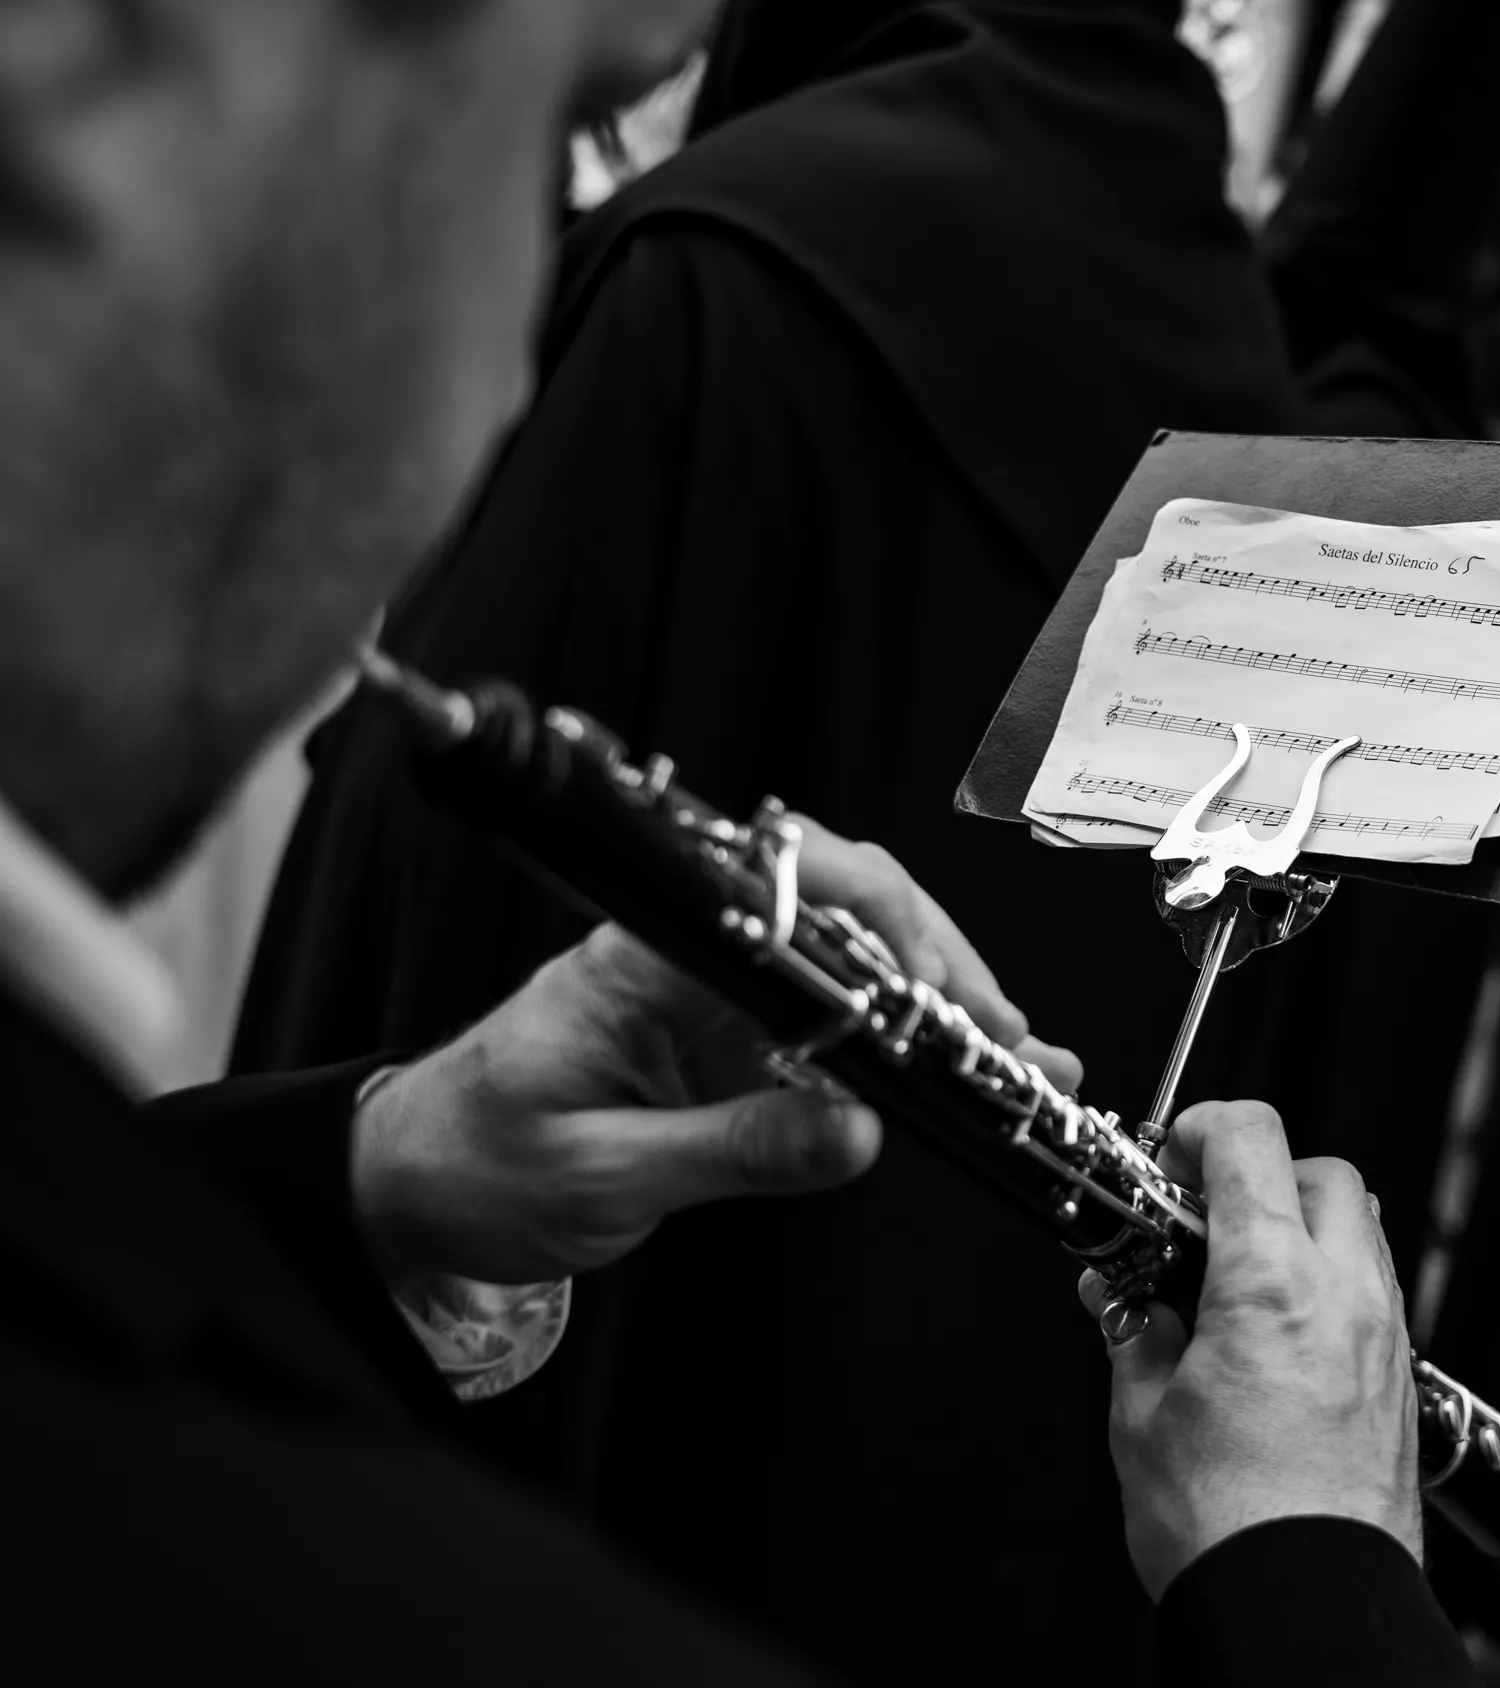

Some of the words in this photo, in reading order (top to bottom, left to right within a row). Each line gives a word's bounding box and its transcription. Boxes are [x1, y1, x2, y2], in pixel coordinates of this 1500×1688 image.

[1179, 515, 1201, 527] Oboe
[1192, 552, 1211, 561] Saeta
[1318, 543, 1360, 561] Saetas
[1362, 550, 1384, 564] del
[1385, 553, 1439, 571] Silencio
[1447, 556, 1486, 575] 65
[1130, 694, 1148, 705] Saeta
